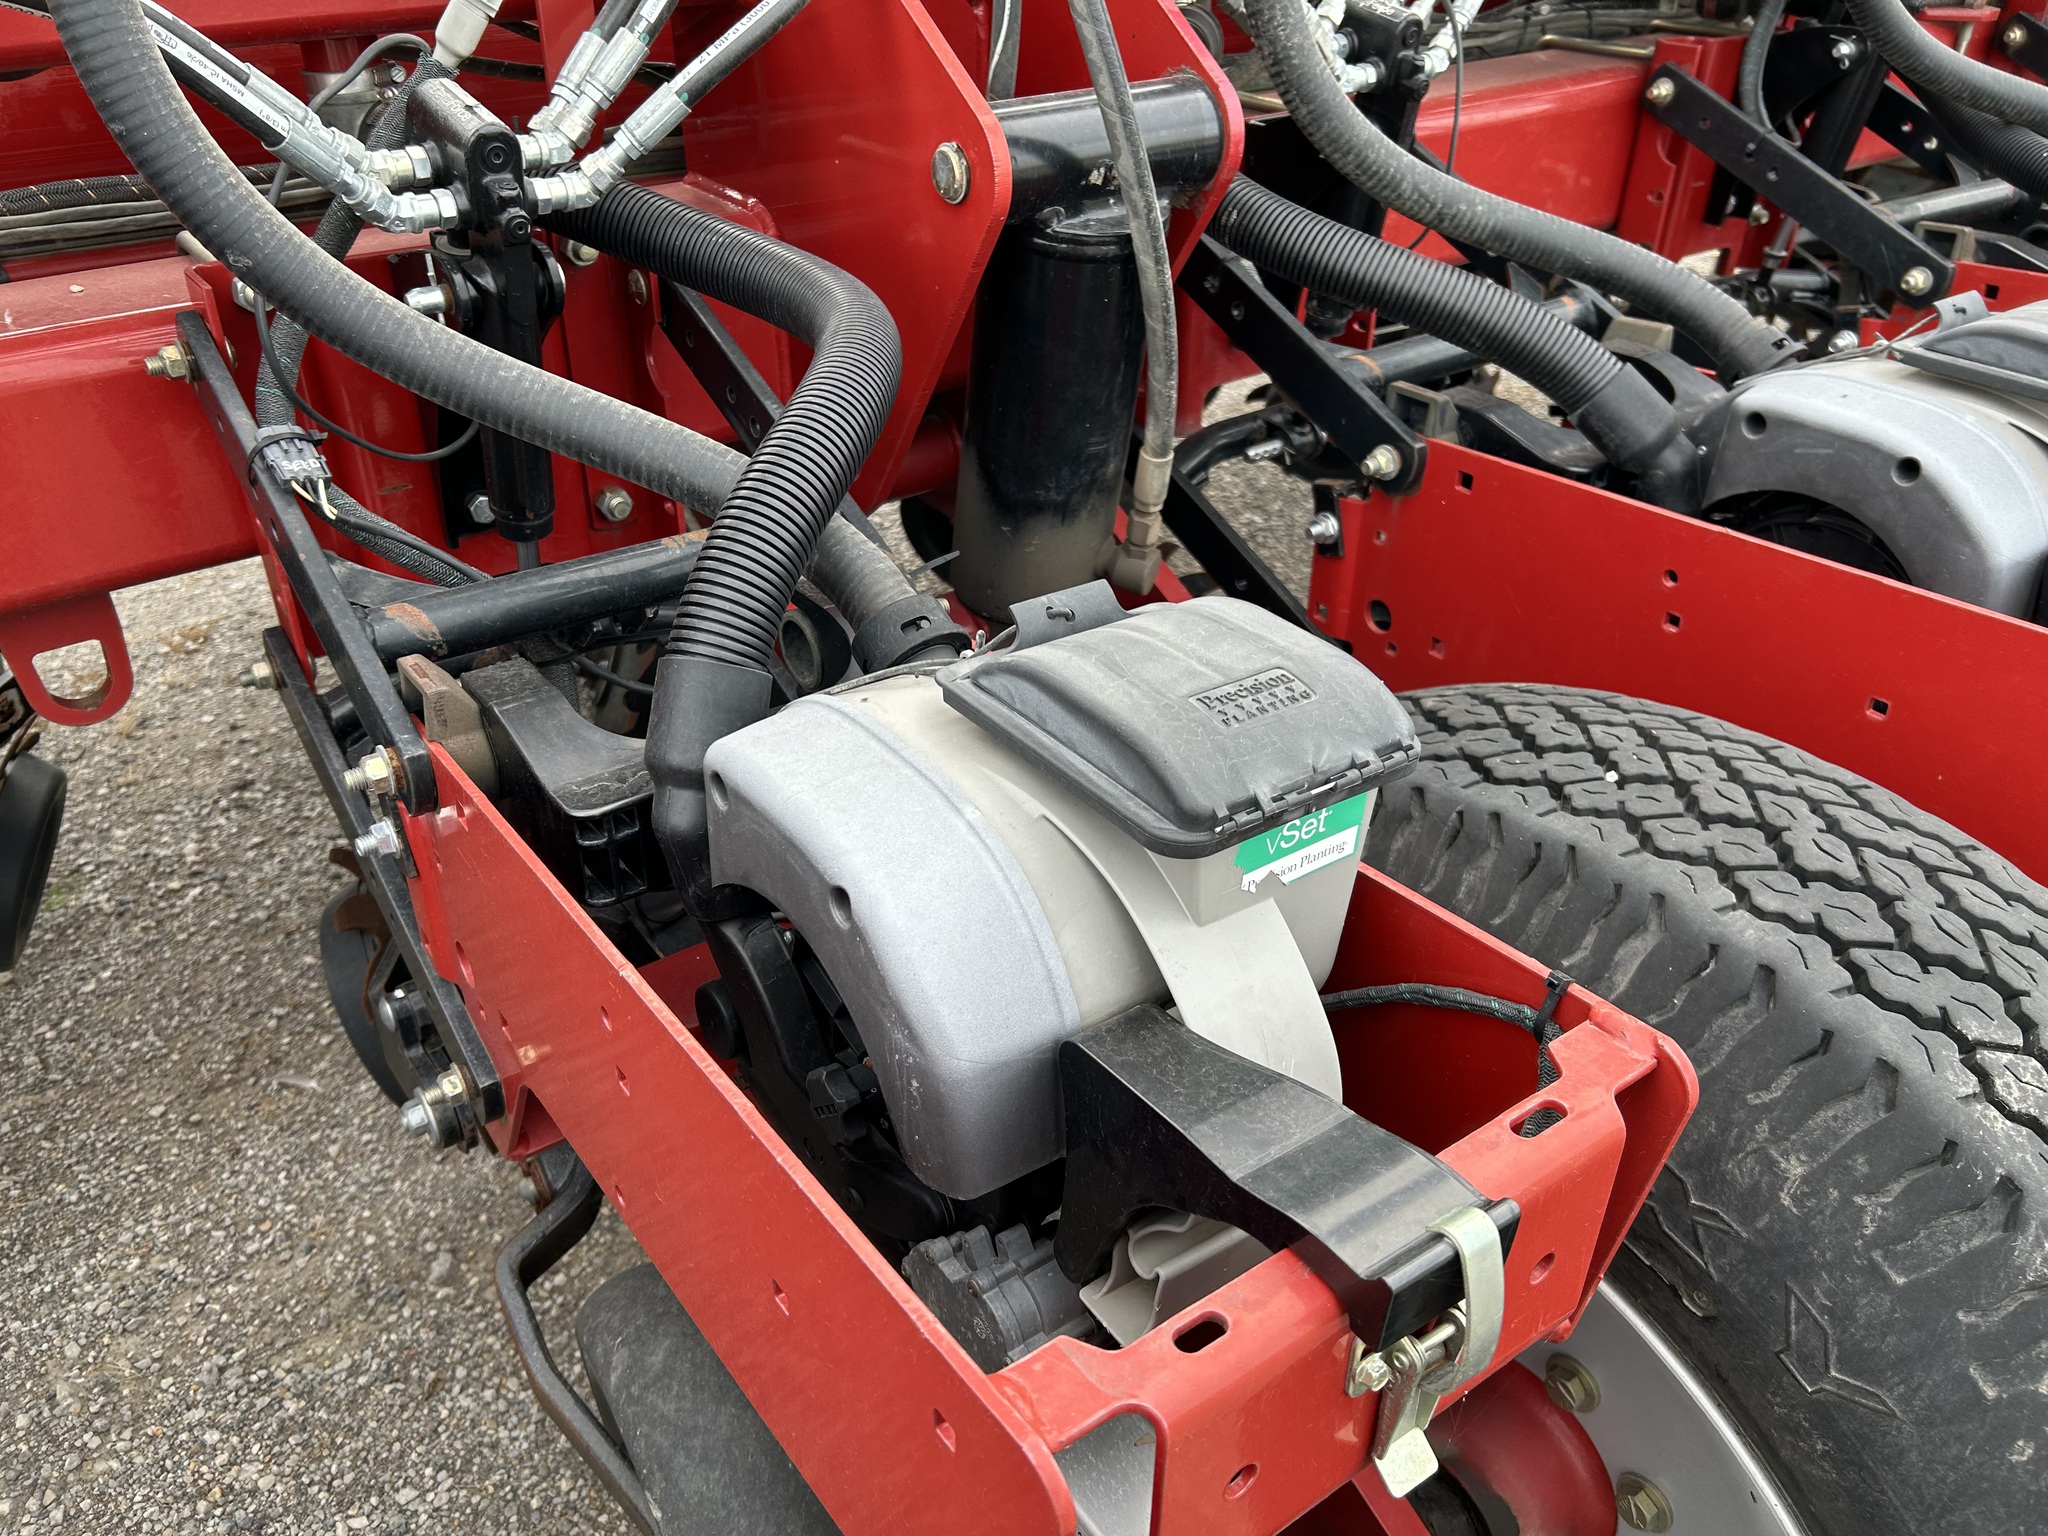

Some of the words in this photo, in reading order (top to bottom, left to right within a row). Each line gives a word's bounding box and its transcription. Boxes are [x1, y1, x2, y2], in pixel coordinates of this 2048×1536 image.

[699, 51, 711, 64] 21
[713, 28, 740, 49] MPa
[221, 76, 245, 98] MSHA
[281, 459, 322, 472] SEED
[1196, 673, 1296, 711] Precision
[1221, 690, 1312, 728] PLANTING
[1266, 807, 1329, 855] vSet
[1299, 841, 1347, 869] Planting
